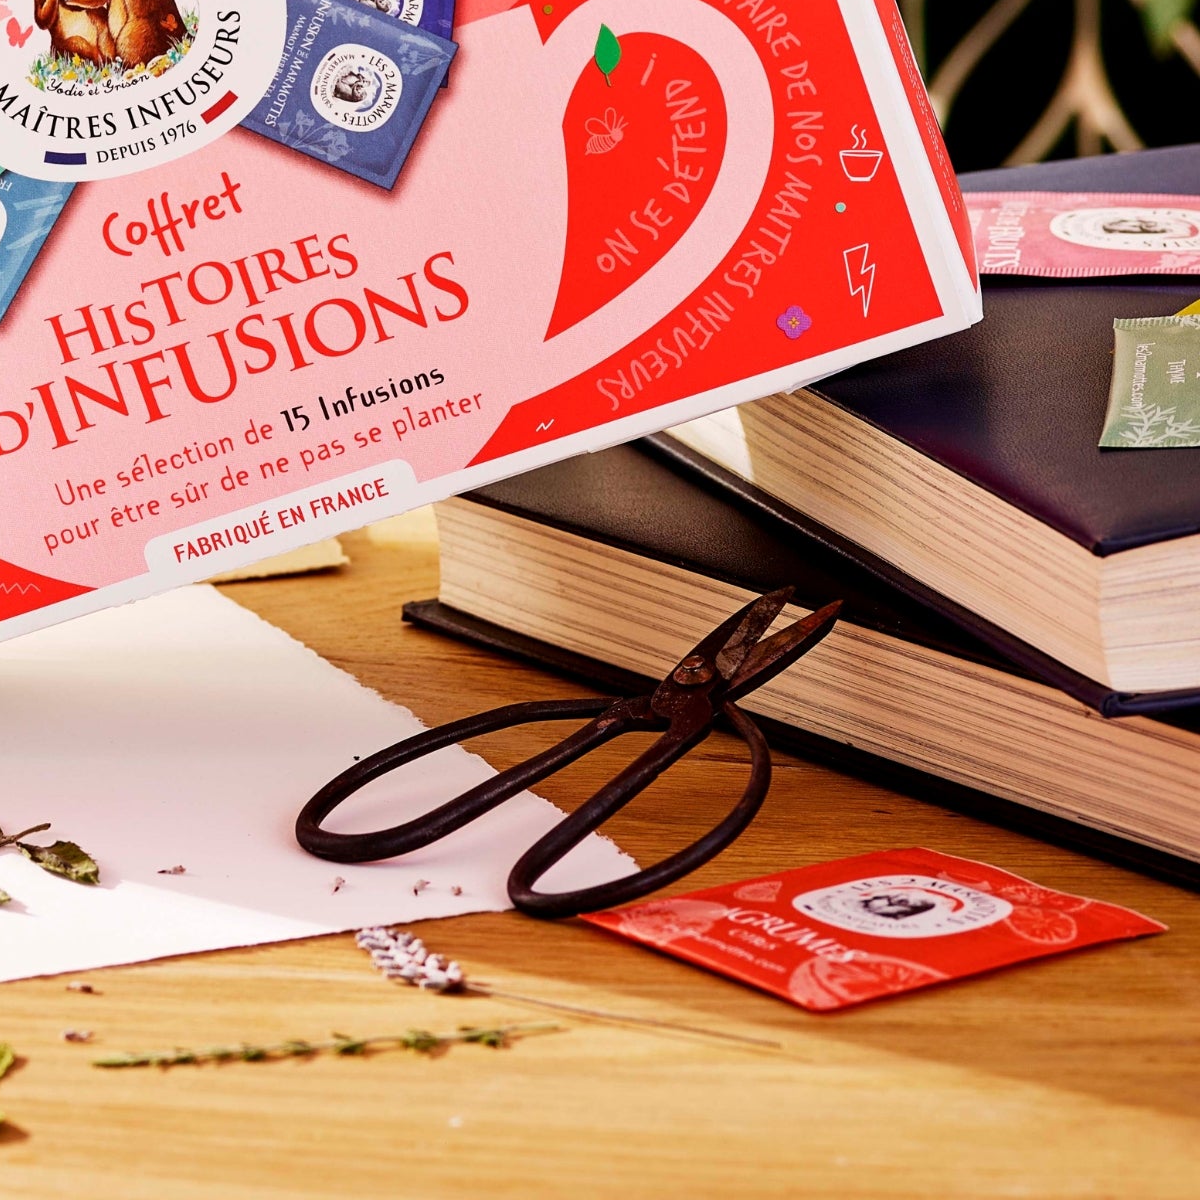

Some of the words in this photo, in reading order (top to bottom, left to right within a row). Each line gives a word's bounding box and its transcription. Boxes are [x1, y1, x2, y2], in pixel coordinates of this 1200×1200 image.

[128, 7, 243, 132] INFUSEURS
[264, 56, 306, 128] MARMOTTES
[368, 55, 389, 74] LES
[386, 70, 397, 81] 2
[780, 59, 818, 101] DE
[340, 81, 398, 127] MARMOTTES
[786, 110, 825, 167] NOS
[96, 138, 157, 165] DEPUIS
[159, 121, 200, 148] 1976
[596, 228, 640, 274] ON
[629, 198, 674, 241] SE
[656, 79, 708, 204] DÉTEND
[101, 171, 243, 258] Coffret
[44, 233, 360, 365] HISTOIRES
[595, 294, 736, 413] INFUSEURS
[1129, 341, 1155, 409] les2marmottes.com
[1166, 358, 1187, 385] THYME
[54, 476, 107, 507] Une
[115, 433, 235, 488] sélection
[244, 416, 274, 446] de
[280, 404, 312, 433] 15
[318, 364, 447, 422] Infusions
[43, 519, 102, 556] pour
[110, 498, 161, 531] être
[170, 480, 210, 510] sûr
[220, 463, 250, 493] de
[258, 452, 291, 477] ne
[299, 437, 347, 472] pas
[353, 424, 385, 448] se
[391, 390, 485, 442] planter
[172, 510, 275, 565] FABRIQUÉ
[279, 507, 307, 532] EN
[310, 476, 391, 521] FRANCE
